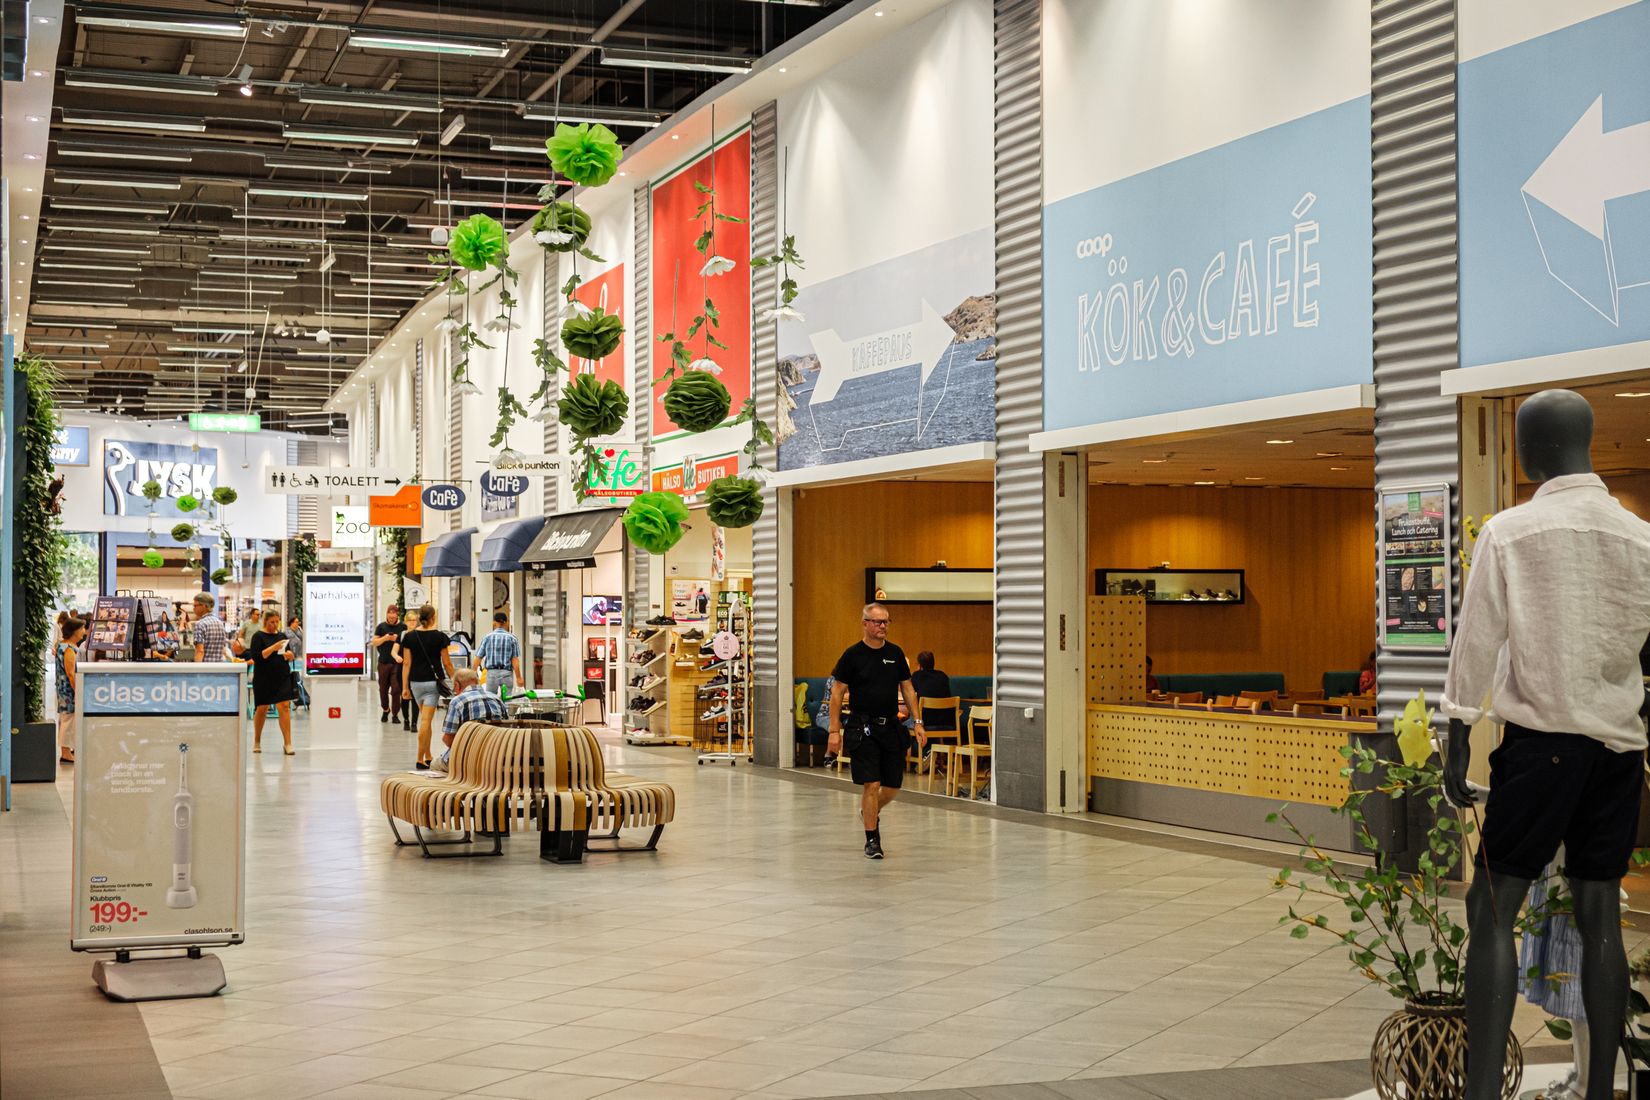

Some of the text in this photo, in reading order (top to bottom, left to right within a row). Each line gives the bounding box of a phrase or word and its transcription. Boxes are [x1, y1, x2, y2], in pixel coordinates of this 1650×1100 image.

[1076, 232, 1114, 259] coop
[851, 331, 913, 373] KAFFEPAUS
[524, 461, 560, 471] punkten
[128, 459, 217, 501] JYSK
[324, 475, 380, 487] TOALETT
[662, 472, 681, 490] HÄLSO
[697, 466, 726, 485] BUTIKEN
[335, 522, 371, 534] ZOO
[1391, 526, 1439, 536] Lunch och Catering
[94, 680, 231, 703] clas ohlson
[89, 901, 148, 924] 199:-
[89, 925, 112, 933] (249:-)
[184, 927, 233, 935] clasohlson.se
